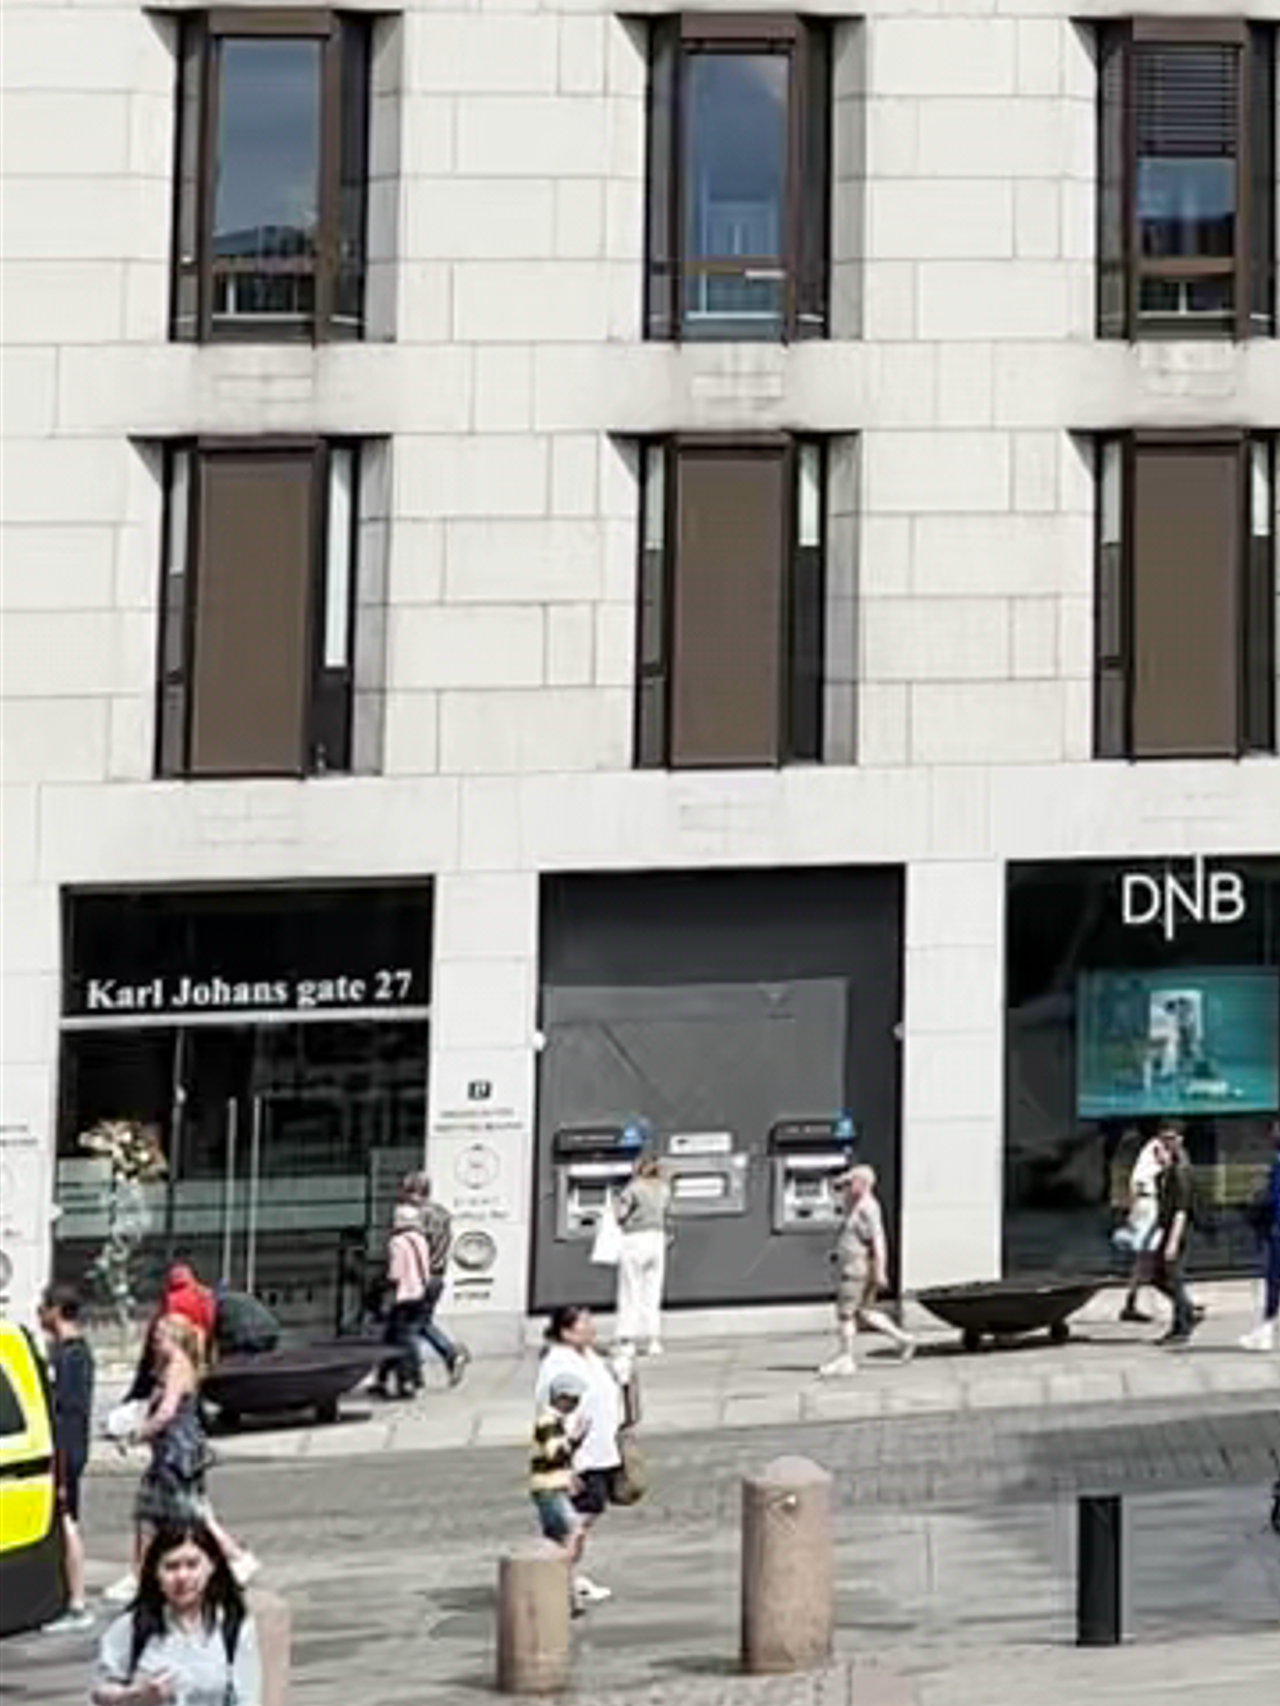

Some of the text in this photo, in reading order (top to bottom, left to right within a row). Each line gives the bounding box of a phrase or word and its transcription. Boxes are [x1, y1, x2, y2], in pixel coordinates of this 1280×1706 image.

[1122, 854, 1246, 941] DNB
[87, 969, 412, 1009] Karl Johans gate 27
